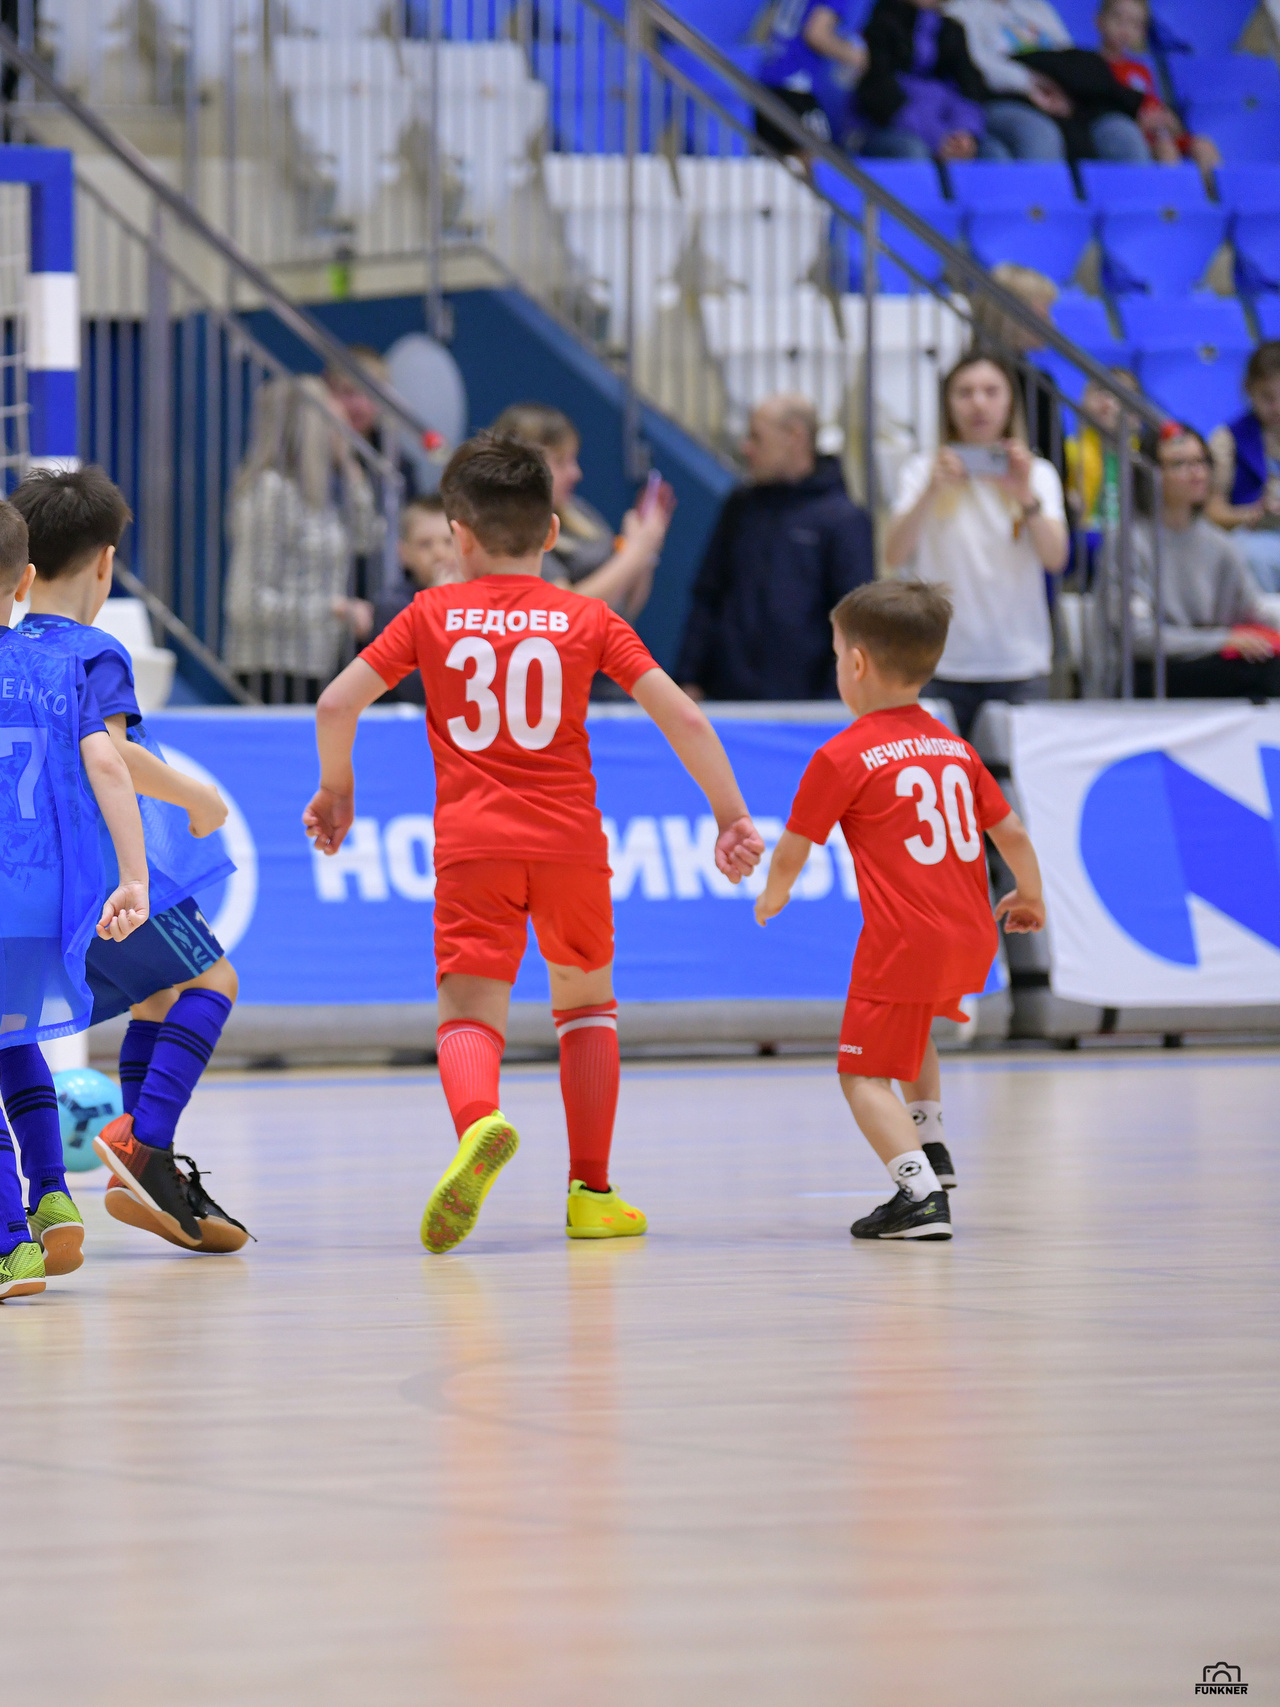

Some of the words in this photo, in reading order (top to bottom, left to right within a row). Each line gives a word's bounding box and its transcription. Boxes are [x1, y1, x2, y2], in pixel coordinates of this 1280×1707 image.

[445, 608, 569, 636] БЕДОЕВ
[445, 636, 563, 752] 30
[860, 734, 972, 771] НЕЧИТАЙЛЕНК
[895, 763, 981, 866] 30
